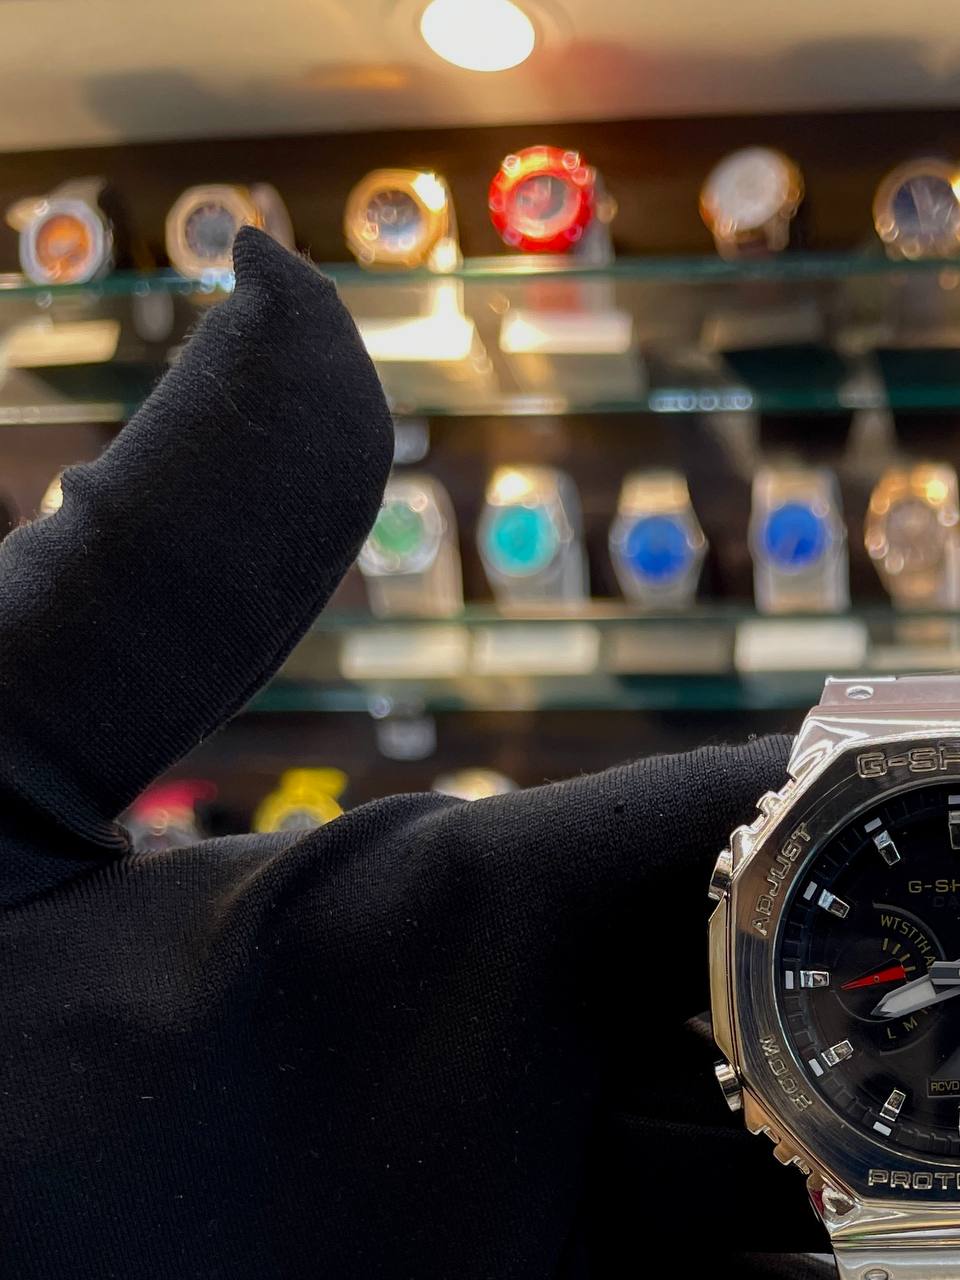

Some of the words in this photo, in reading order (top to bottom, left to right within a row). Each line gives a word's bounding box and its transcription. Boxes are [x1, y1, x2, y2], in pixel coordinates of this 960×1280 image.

[751, 821, 811, 937] ADJUST
[760, 1033, 813, 1112] MODE
[930, 1081, 960, 1092] RCVD
